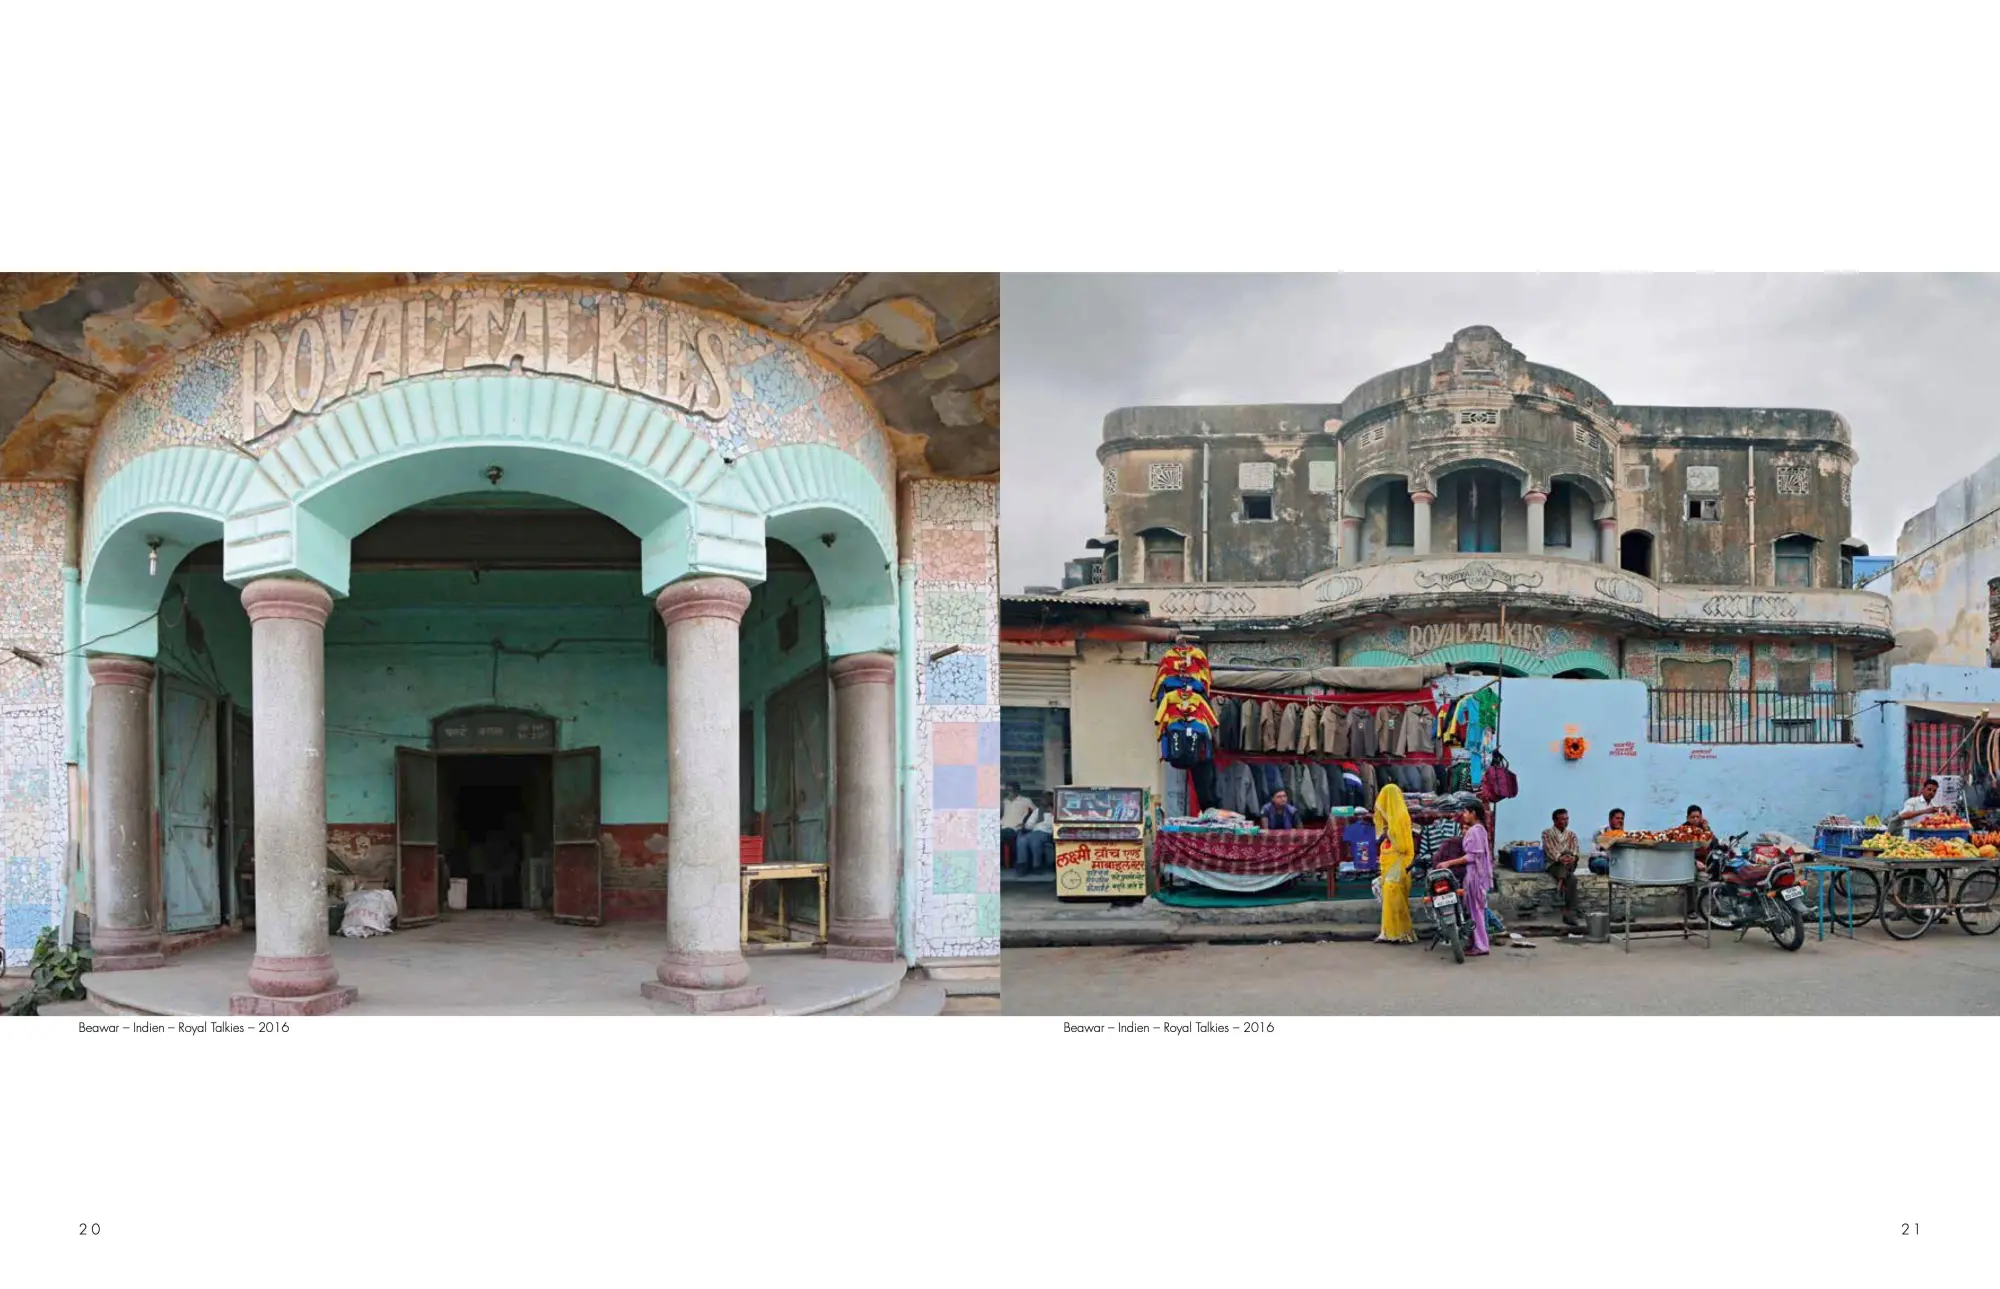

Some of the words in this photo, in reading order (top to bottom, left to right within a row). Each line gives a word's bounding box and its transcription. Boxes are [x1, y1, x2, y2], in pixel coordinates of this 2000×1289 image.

[242, 300, 453, 443] ROYAL
[449, 298, 732, 420] TALKIES
[1409, 623, 1465, 656] ROYAL
[1465, 622, 1543, 651] TALKIES
[1056, 843, 1091, 868] लक्ष्मी
